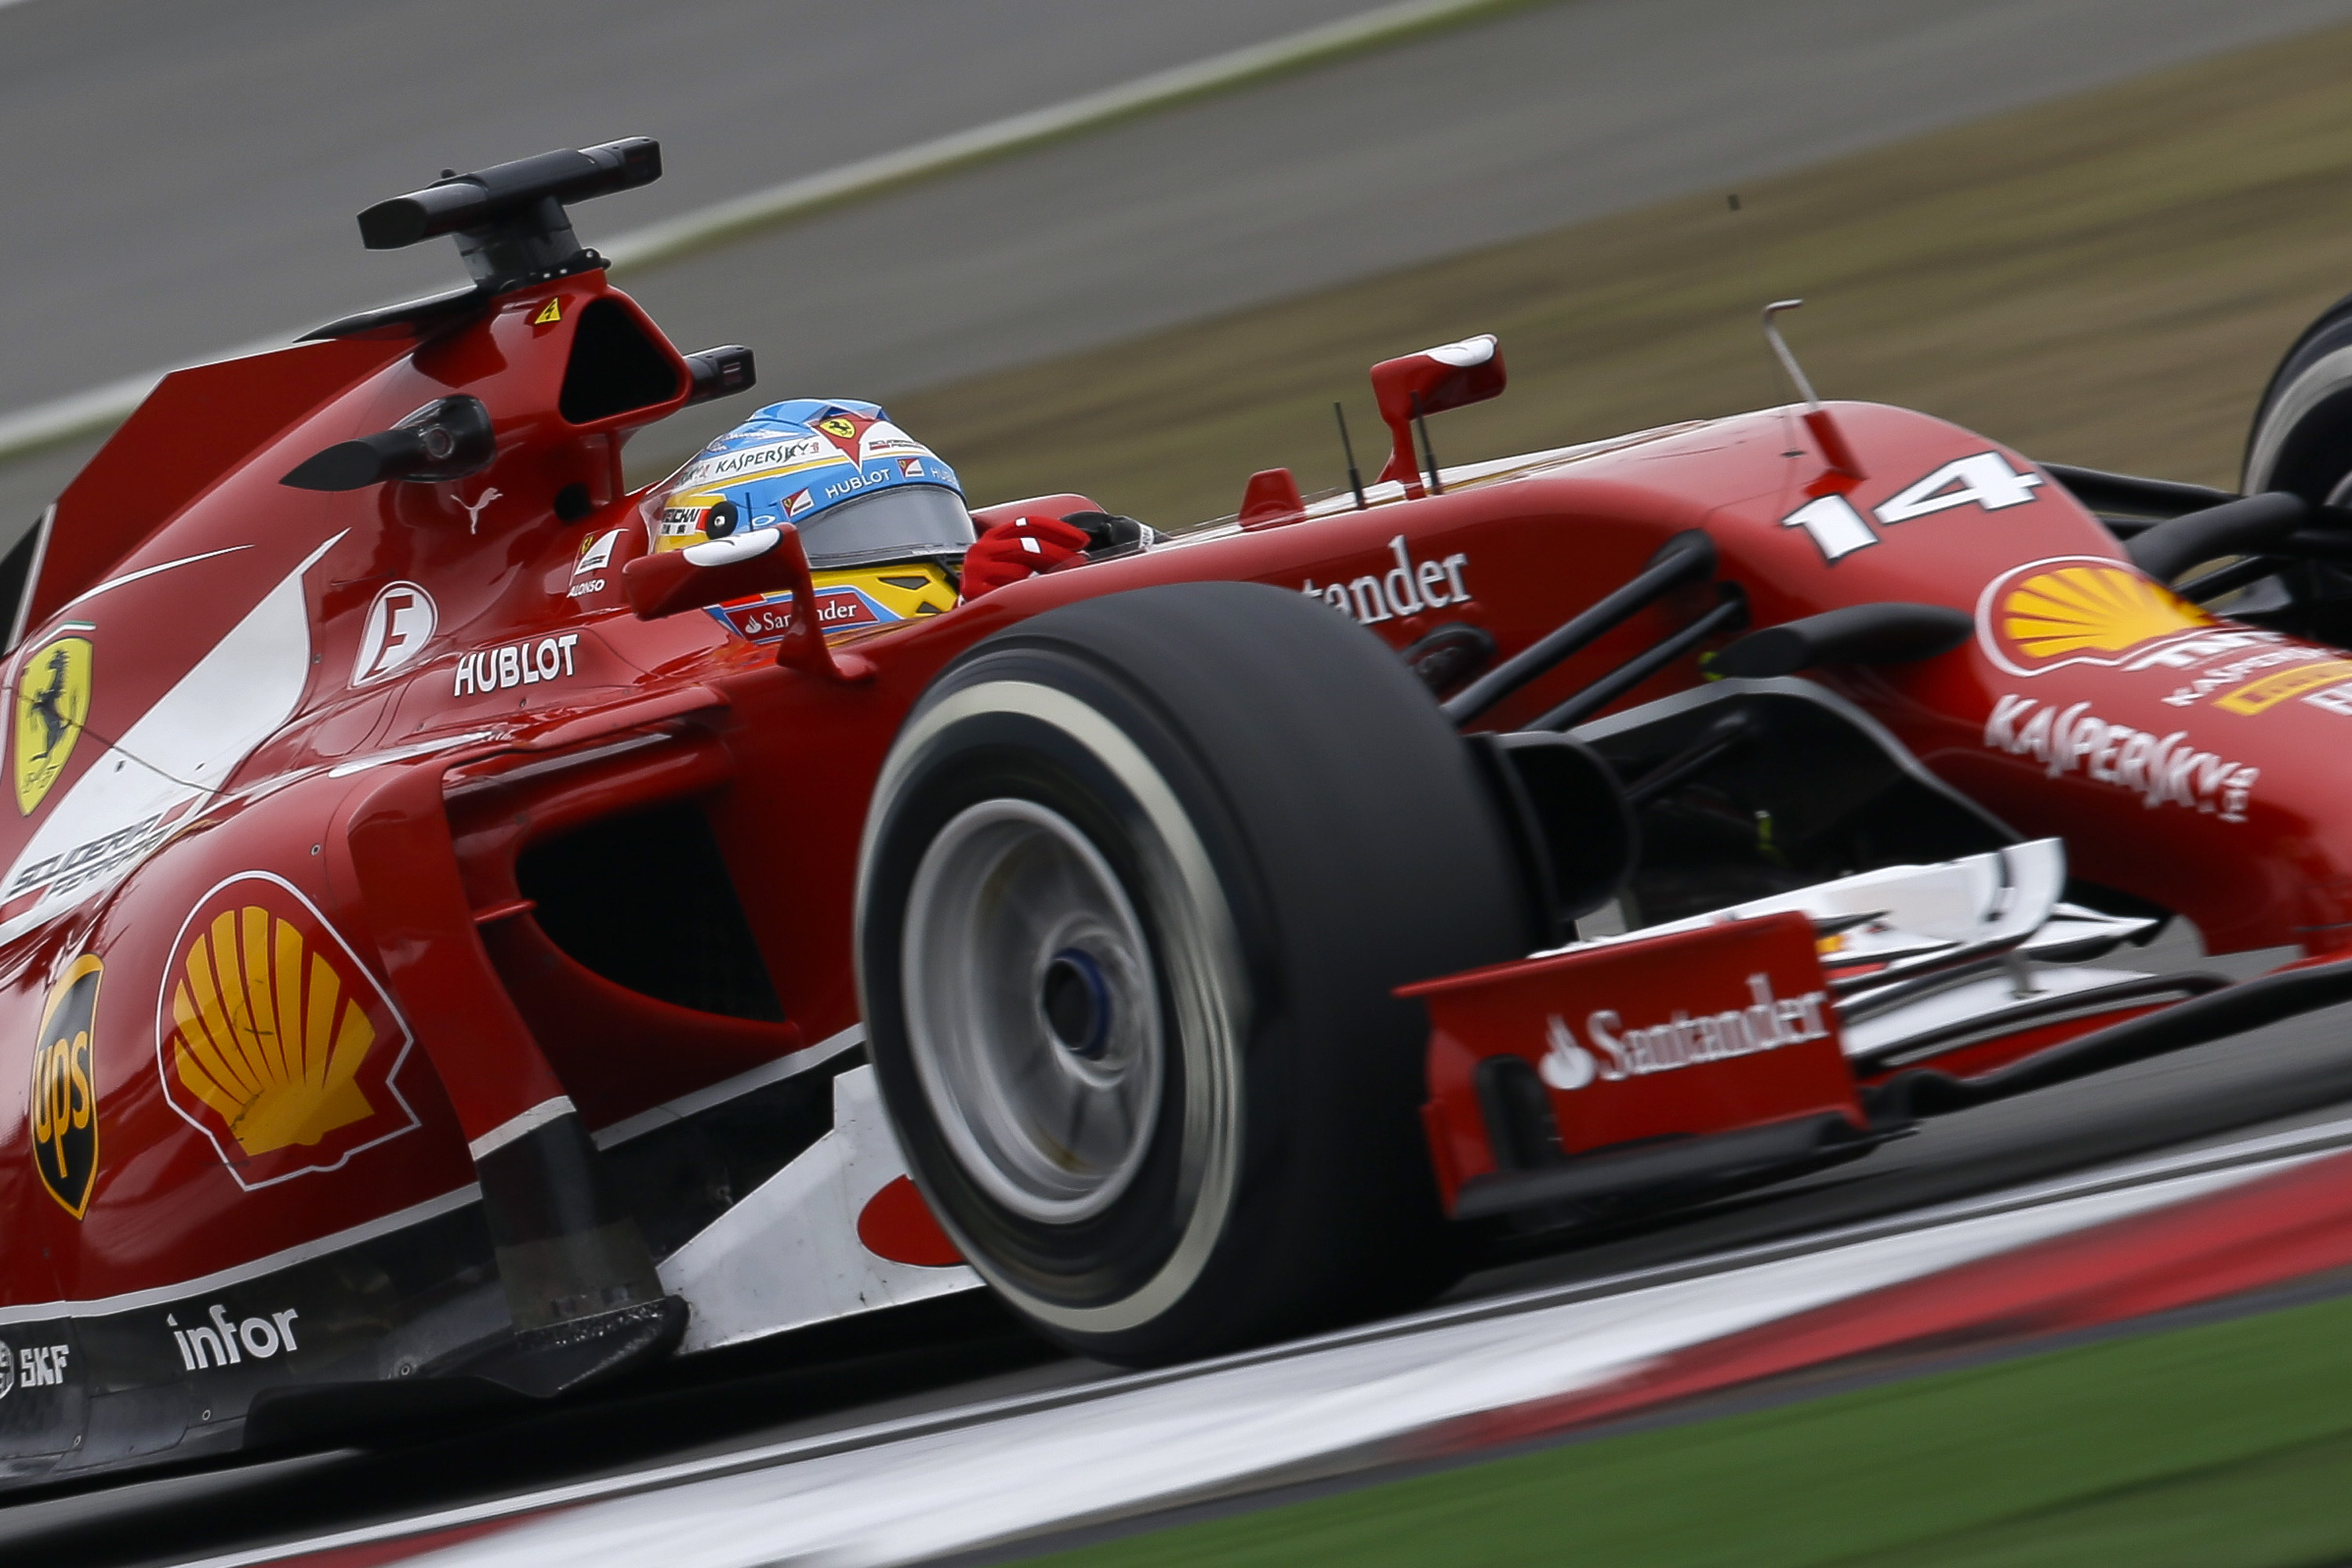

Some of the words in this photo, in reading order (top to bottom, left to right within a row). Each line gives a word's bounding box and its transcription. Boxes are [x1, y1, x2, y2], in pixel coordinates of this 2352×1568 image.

[715, 442, 810, 474] KASPERSKY
[825, 468, 891, 499] HUBLOT
[1780, 450, 2044, 566] 14
[566, 579, 605, 597] ALONSO
[453, 633, 579, 697] HUBLOT
[1984, 693, 2244, 814] KASPERSKY
[1586, 972, 1830, 1081] Santander
[35, 1030, 91, 1179] ups
[20, 1344, 70, 1388] SKF
[166, 1304, 299, 1371] infor
